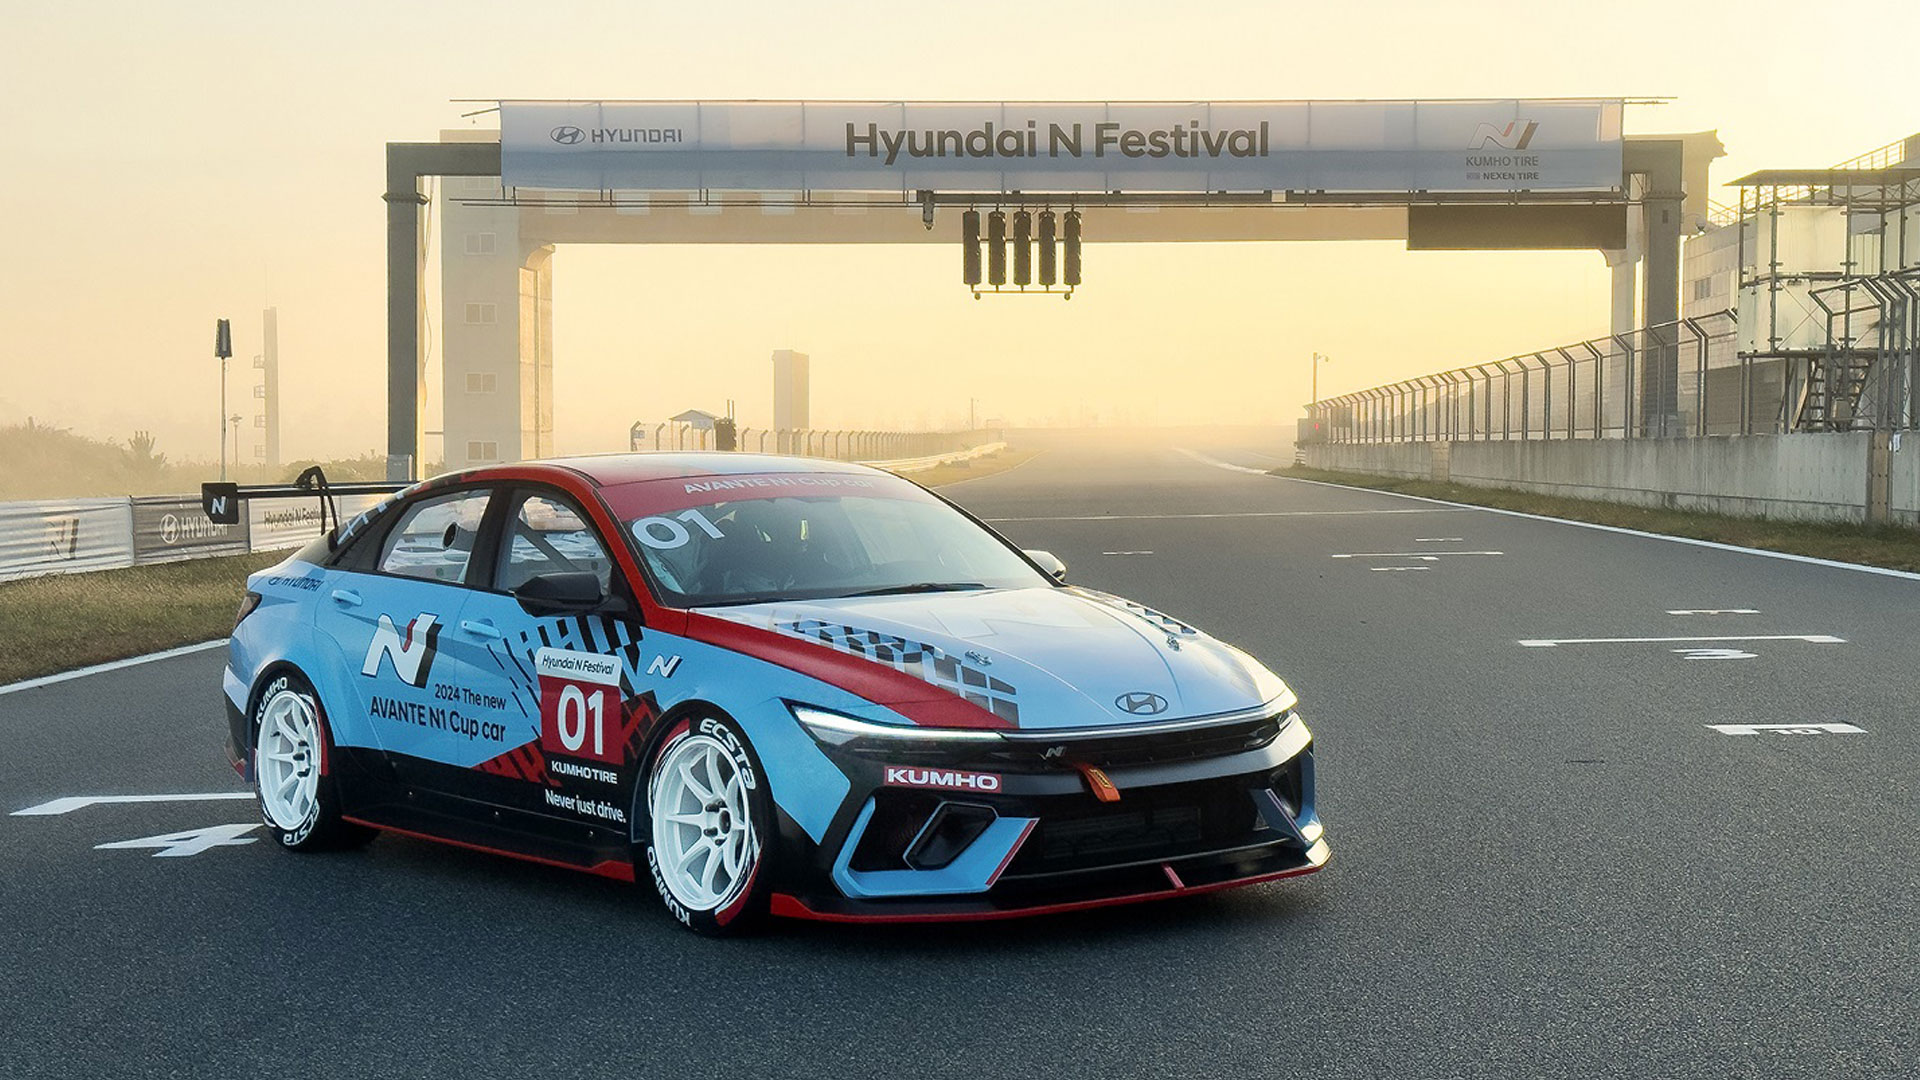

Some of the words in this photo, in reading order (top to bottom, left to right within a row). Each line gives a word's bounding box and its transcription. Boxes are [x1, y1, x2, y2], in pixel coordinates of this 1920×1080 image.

[591, 128, 682, 143] HYUNDAI
[845, 121, 1036, 166] Hyundai
[1049, 123, 1081, 158] N
[1096, 120, 1269, 158] Festival
[1466, 156, 1511, 167] KUMHO
[1513, 156, 1539, 167] TIRE
[1483, 172, 1515, 180] NEXEN
[1517, 172, 1540, 180] TIRE
[684, 478, 766, 494] AVANTE
[211, 496, 227, 514] N
[631, 508, 725, 549] 01
[542, 655, 575, 670] Hyundai
[574, 659, 584, 671] N
[582, 660, 615, 675] Festival
[256, 676, 288, 725] KUMHO
[434, 683, 461, 701] 2024
[461, 687, 483, 706] The
[482, 694, 507, 710] new
[370, 695, 427, 727] AVANTE
[428, 706, 448, 731] N1
[449, 710, 480, 741] Cup
[481, 720, 506, 742] car
[557, 684, 604, 755] 01
[551, 760, 592, 779] KUMHO
[591, 768, 618, 785] TIRE
[887, 768, 998, 790] KUMHO
[544, 788, 576, 810] Never
[575, 794, 597, 816] just
[596, 800, 627, 824] drive.
[647, 846, 691, 927] KUMHO
